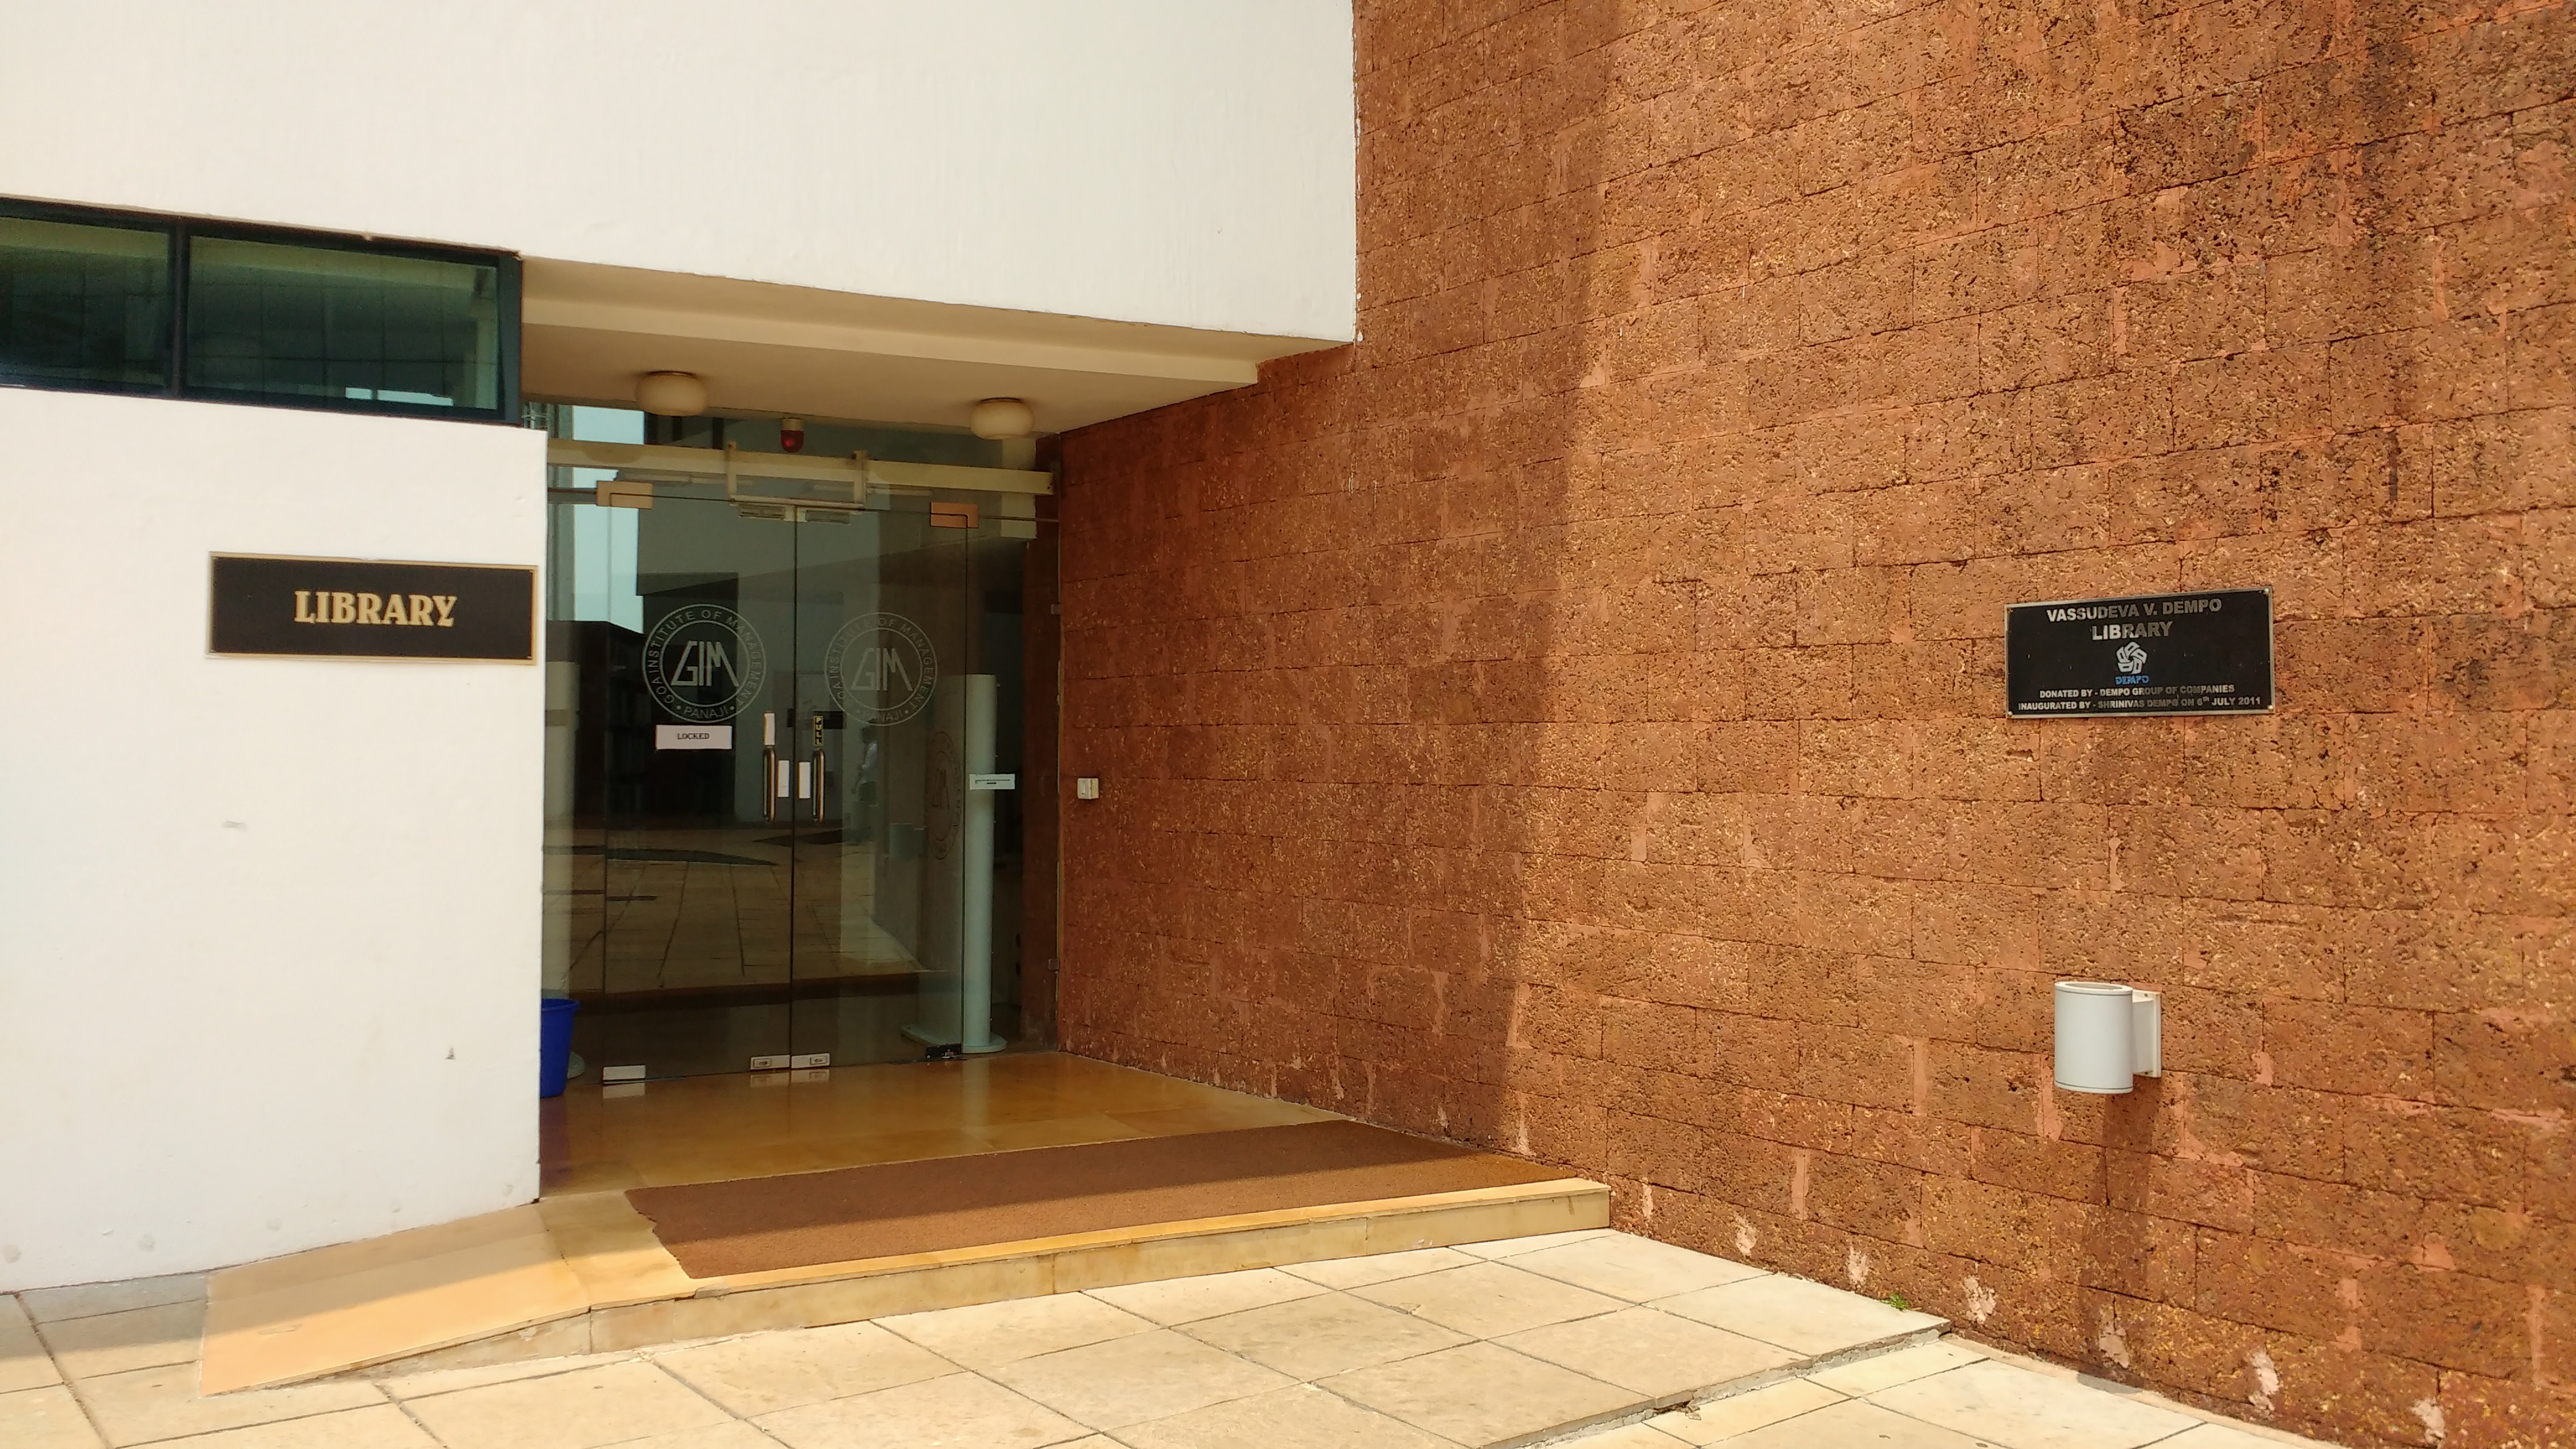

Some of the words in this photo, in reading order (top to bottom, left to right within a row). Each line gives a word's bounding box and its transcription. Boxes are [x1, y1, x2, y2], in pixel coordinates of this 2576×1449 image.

[294, 590, 458, 627] LIBRARY
[2046, 604, 2140, 622] VASSUDEVA
[2143, 603, 2158, 617] V.
[2162, 598, 2223, 615] DEMPO
[877, 617, 898, 627] OF
[2091, 621, 2174, 641] LIBRARY
[648, 611, 696, 674] INSTITUTE
[701, 609, 723, 620] OF
[671, 640, 740, 687] GIM
[851, 647, 914, 692] GIM
[2039, 689, 2079, 698] DONATED
[2081, 689, 2094, 697] BY
[2100, 687, 2130, 697] DEMPO
[2132, 687, 2164, 695] GROUP
[2165, 686, 2178, 694] OF
[2180, 684, 2235, 694] COMPANIES
[2115, 675, 2150, 685] DEMPO
[683, 705, 729, 719] PANAJI
[2018, 700, 2078, 711] INAUGURATED
[2079, 700, 2092, 710] BY
[2097, 699, 2145, 709] SHRINIVAS
[2147, 698, 2178, 708] DEMPO
[2180, 698, 2195, 707] ON
[2211, 697, 2236, 706] JULY
[2238, 696, 2261, 705] 2011
[815, 717, 823, 744] PULL
